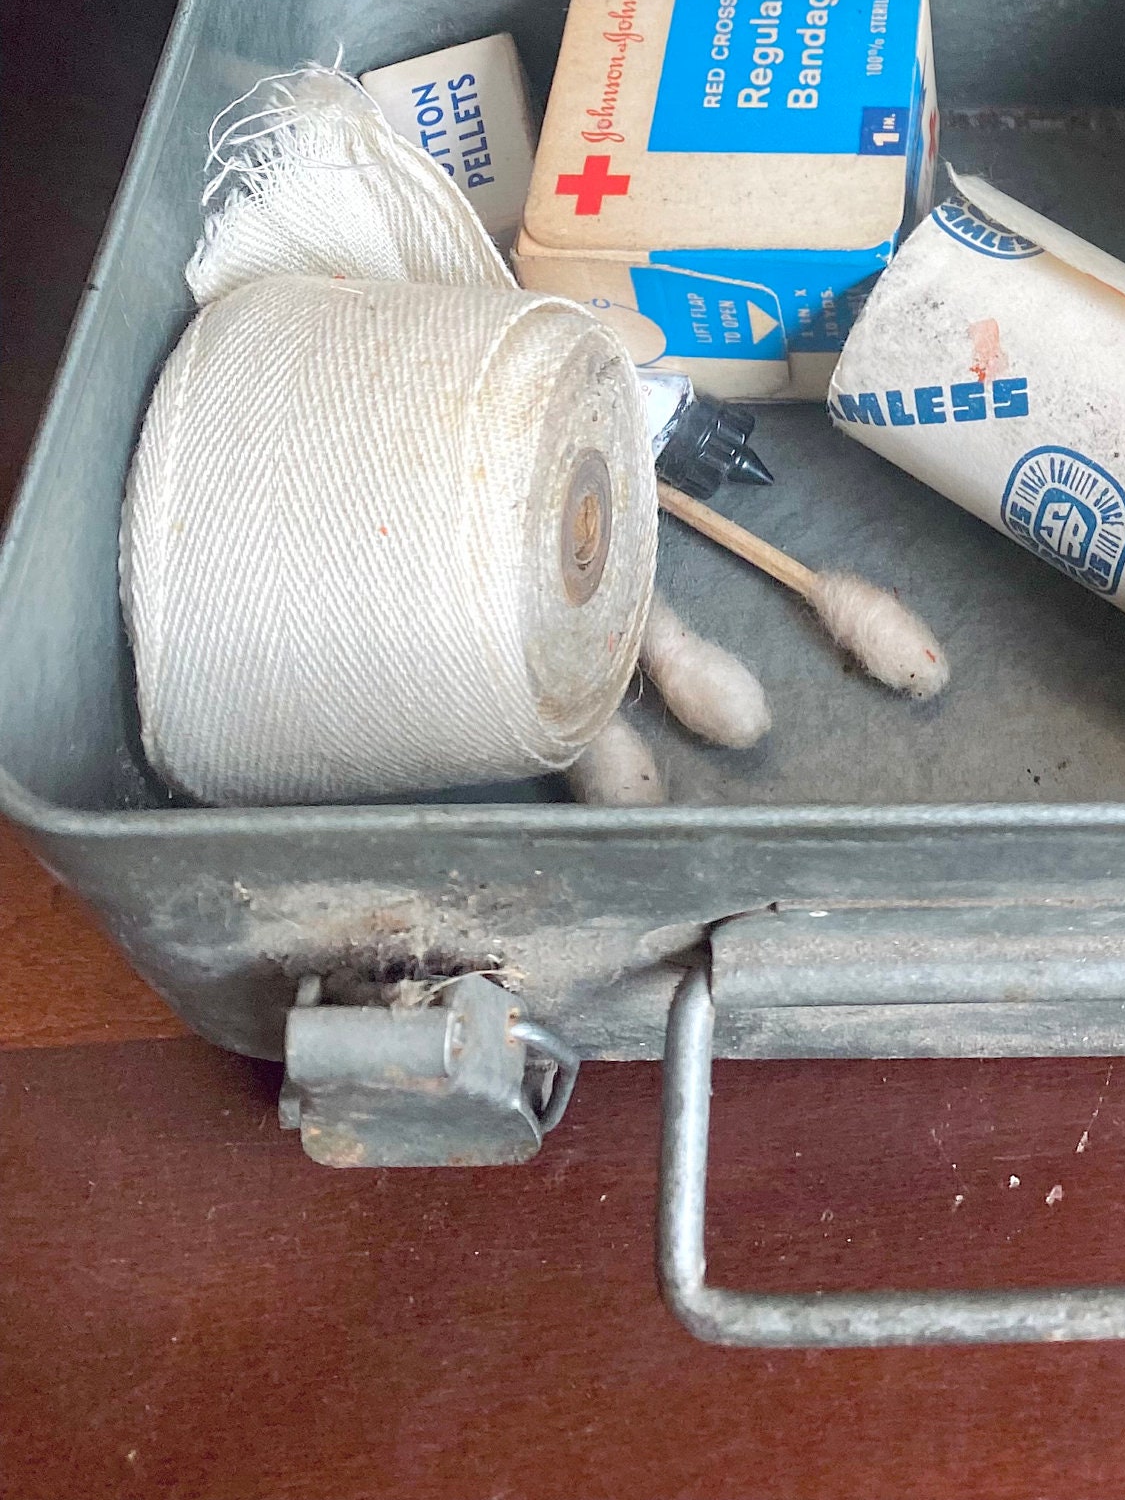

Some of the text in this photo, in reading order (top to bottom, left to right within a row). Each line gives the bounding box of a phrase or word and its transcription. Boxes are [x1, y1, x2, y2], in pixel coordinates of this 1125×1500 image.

[866, 37, 885, 77] 100%
[581, 56, 626, 143] Johnson
[703, 67, 726, 108] RED
[447, 74, 495, 188] PELLETS
[873, 113, 900, 147] 1 IN.
[687, 292, 713, 344] LIFT FLAP
[719, 300, 741, 344] TO OPEN
